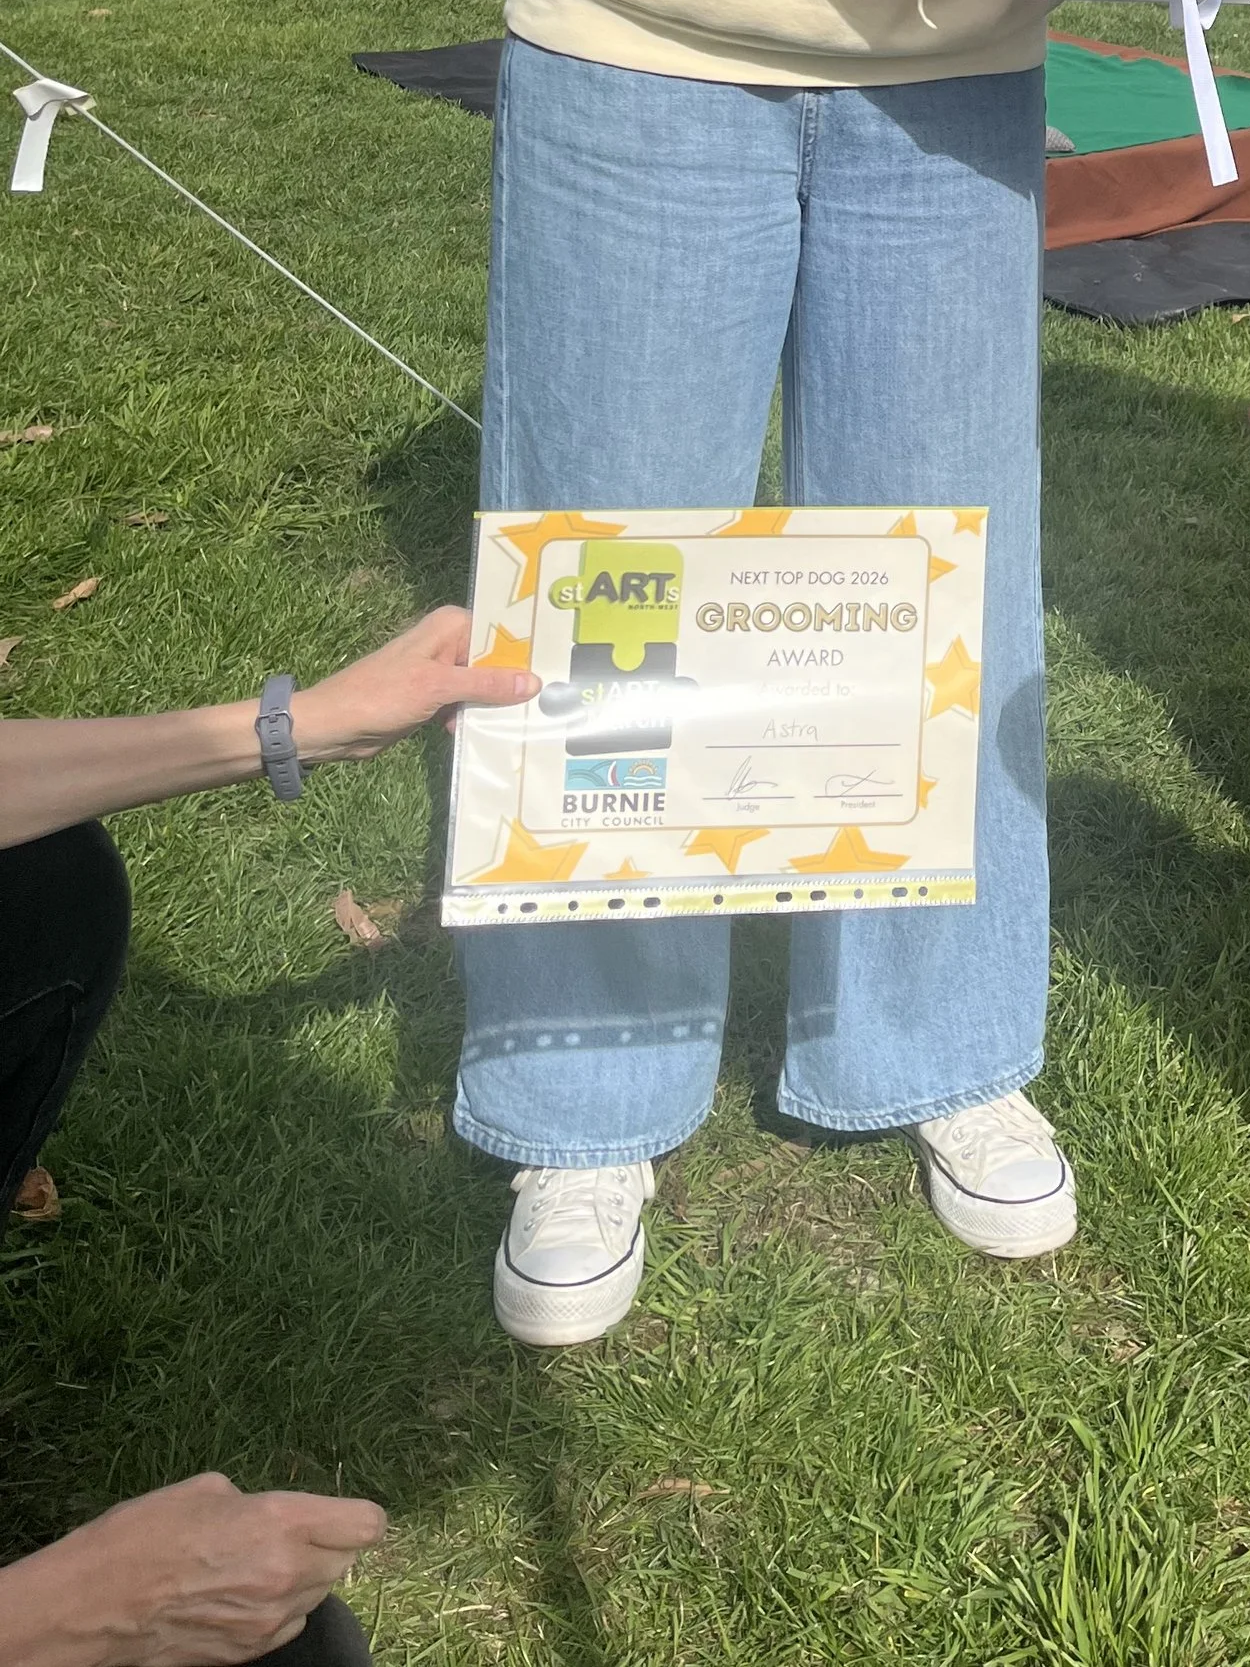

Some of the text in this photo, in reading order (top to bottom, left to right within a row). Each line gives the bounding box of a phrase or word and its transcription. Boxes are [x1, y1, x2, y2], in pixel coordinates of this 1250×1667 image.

[730, 571, 889, 585] NEXT TOP DOG 2026
[560, 571, 680, 604] stARTs
[696, 602, 918, 632] GROOMING
[766, 649, 844, 667] AWARD
[562, 792, 666, 814] BURNIE
[736, 802, 760, 813] Judge
[840, 800, 876, 809] President
[561, 816, 664, 828] CITY COUNCIL
